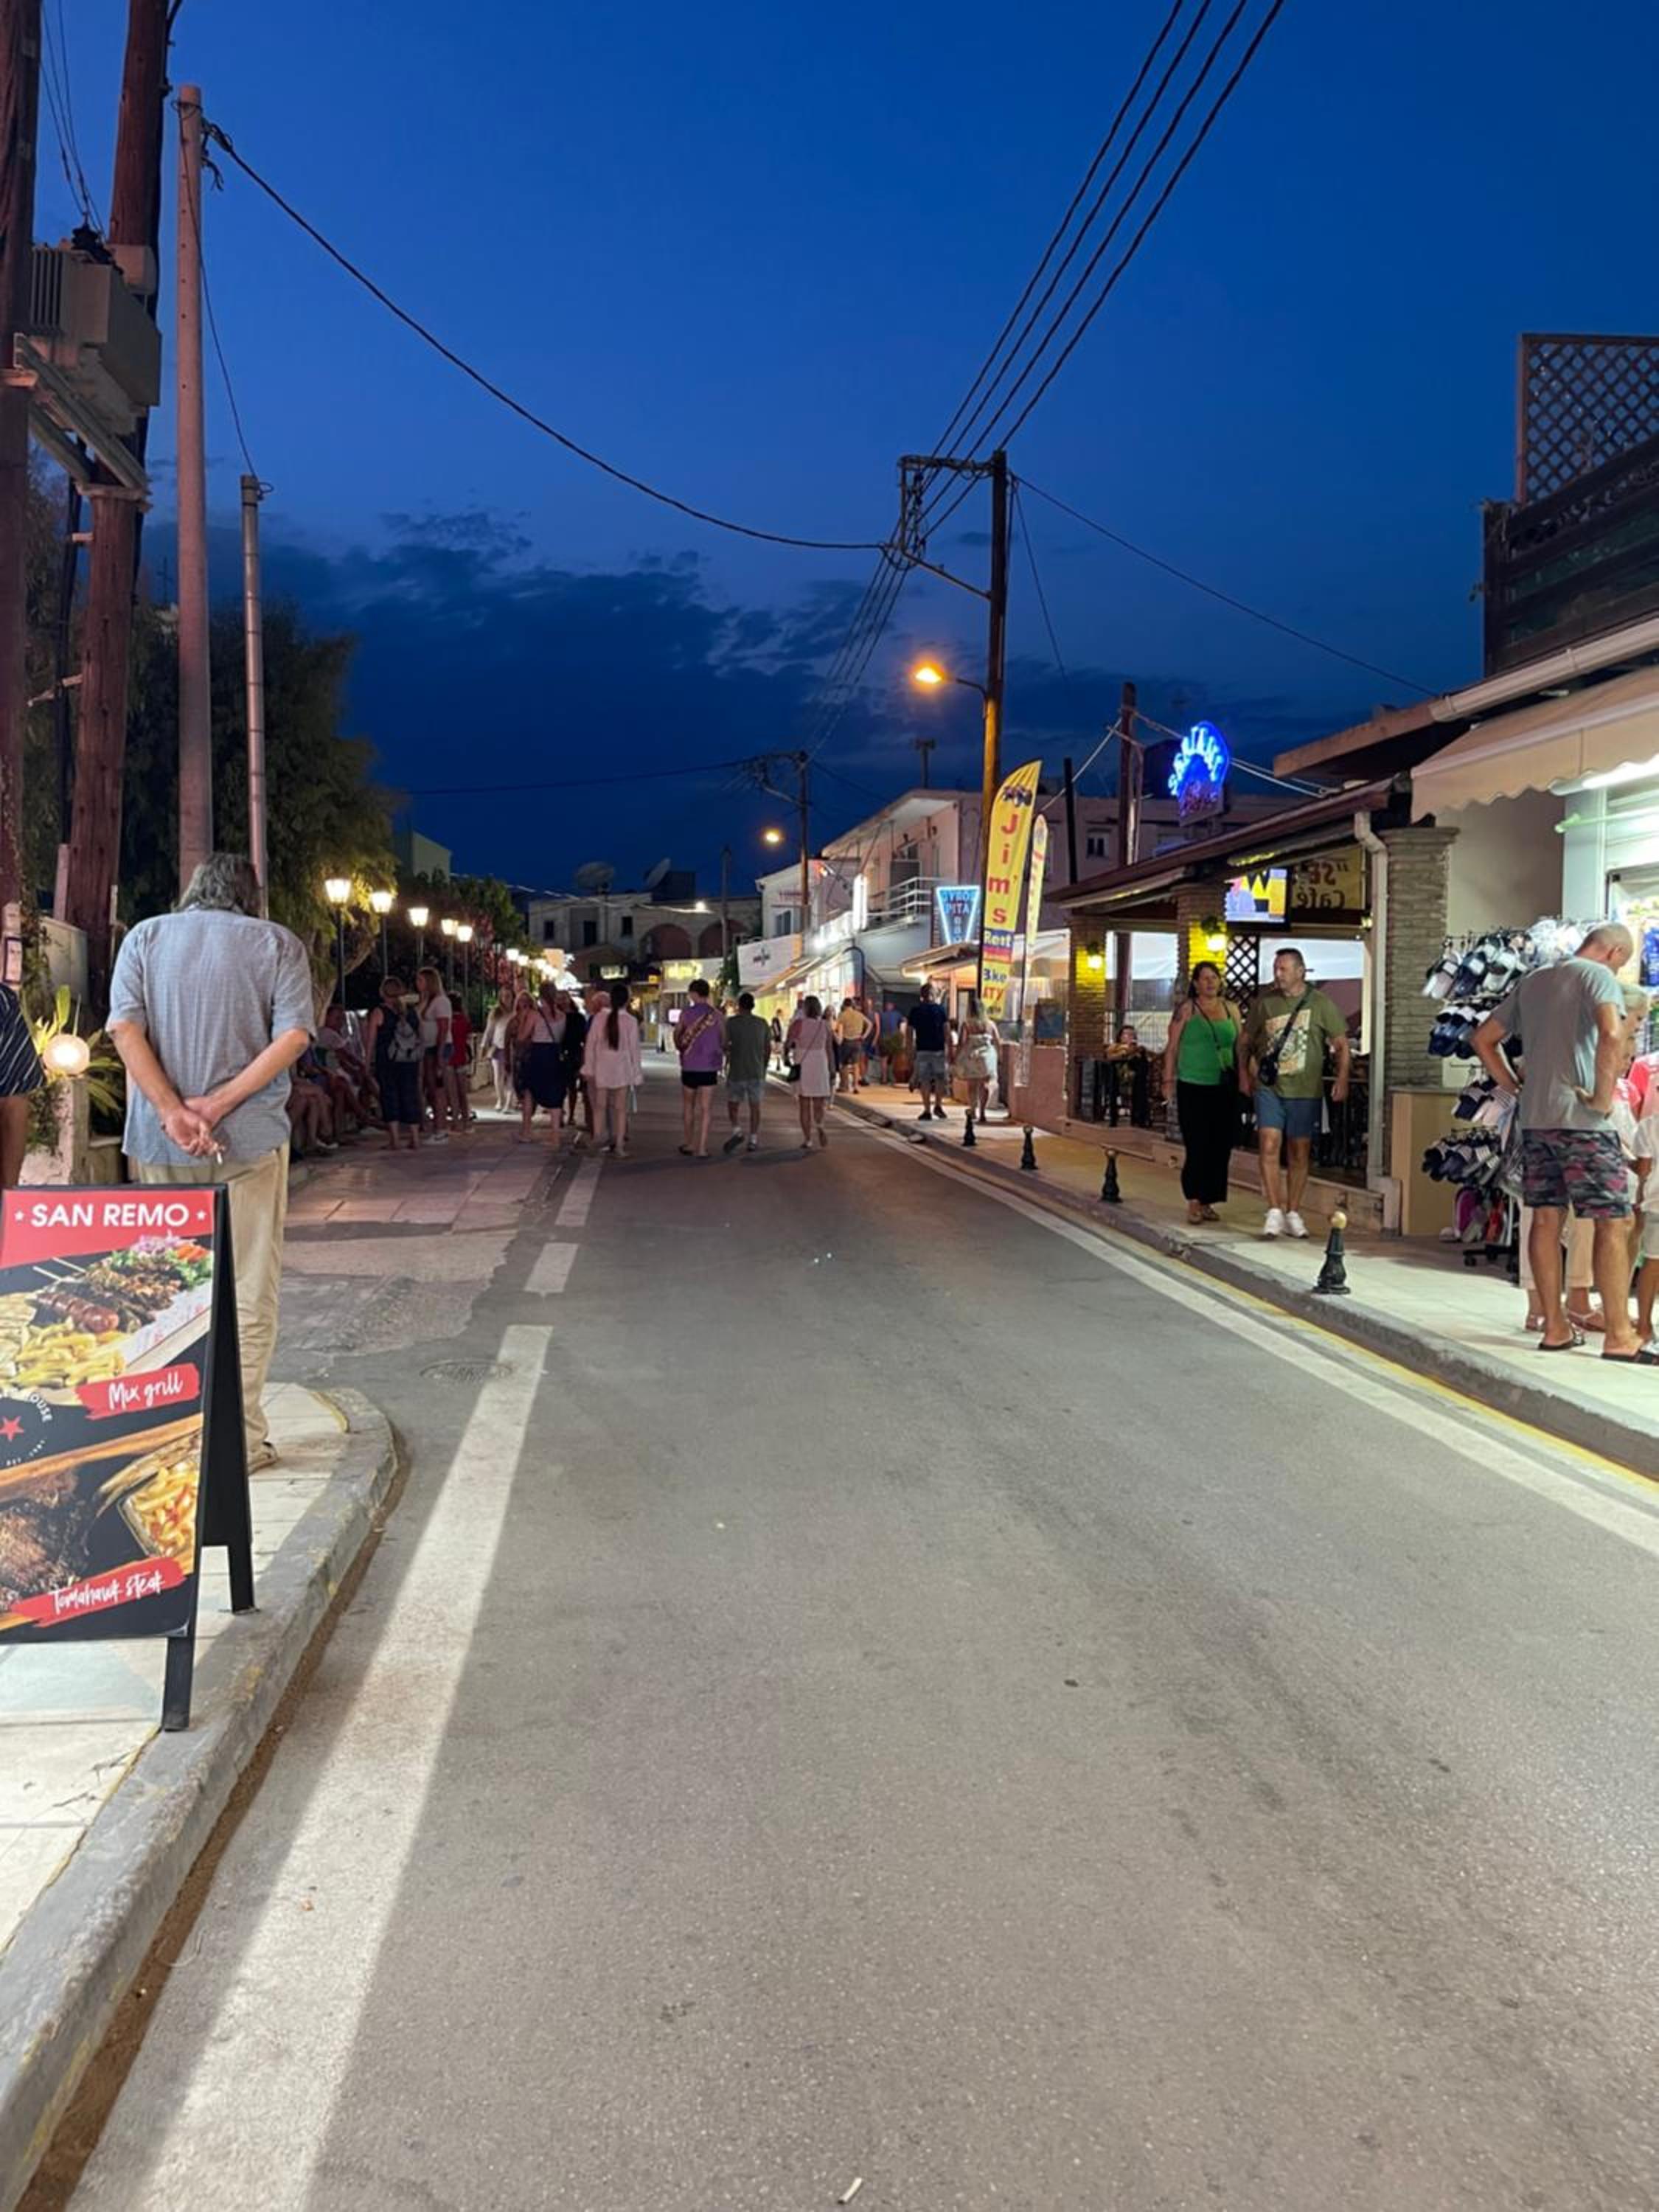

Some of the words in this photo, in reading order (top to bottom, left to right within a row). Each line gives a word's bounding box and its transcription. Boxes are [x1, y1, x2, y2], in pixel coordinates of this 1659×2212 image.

[944, 902, 970, 914] PITA
[31, 1203, 94, 1227] SAN
[103, 1203, 189, 1227] REMO
[108, 1382, 140, 1410] Mix
[144, 1371, 184, 1408] grill
[25, 1392, 52, 1423] OUSE
[48, 1579, 124, 1615] Tomahawk
